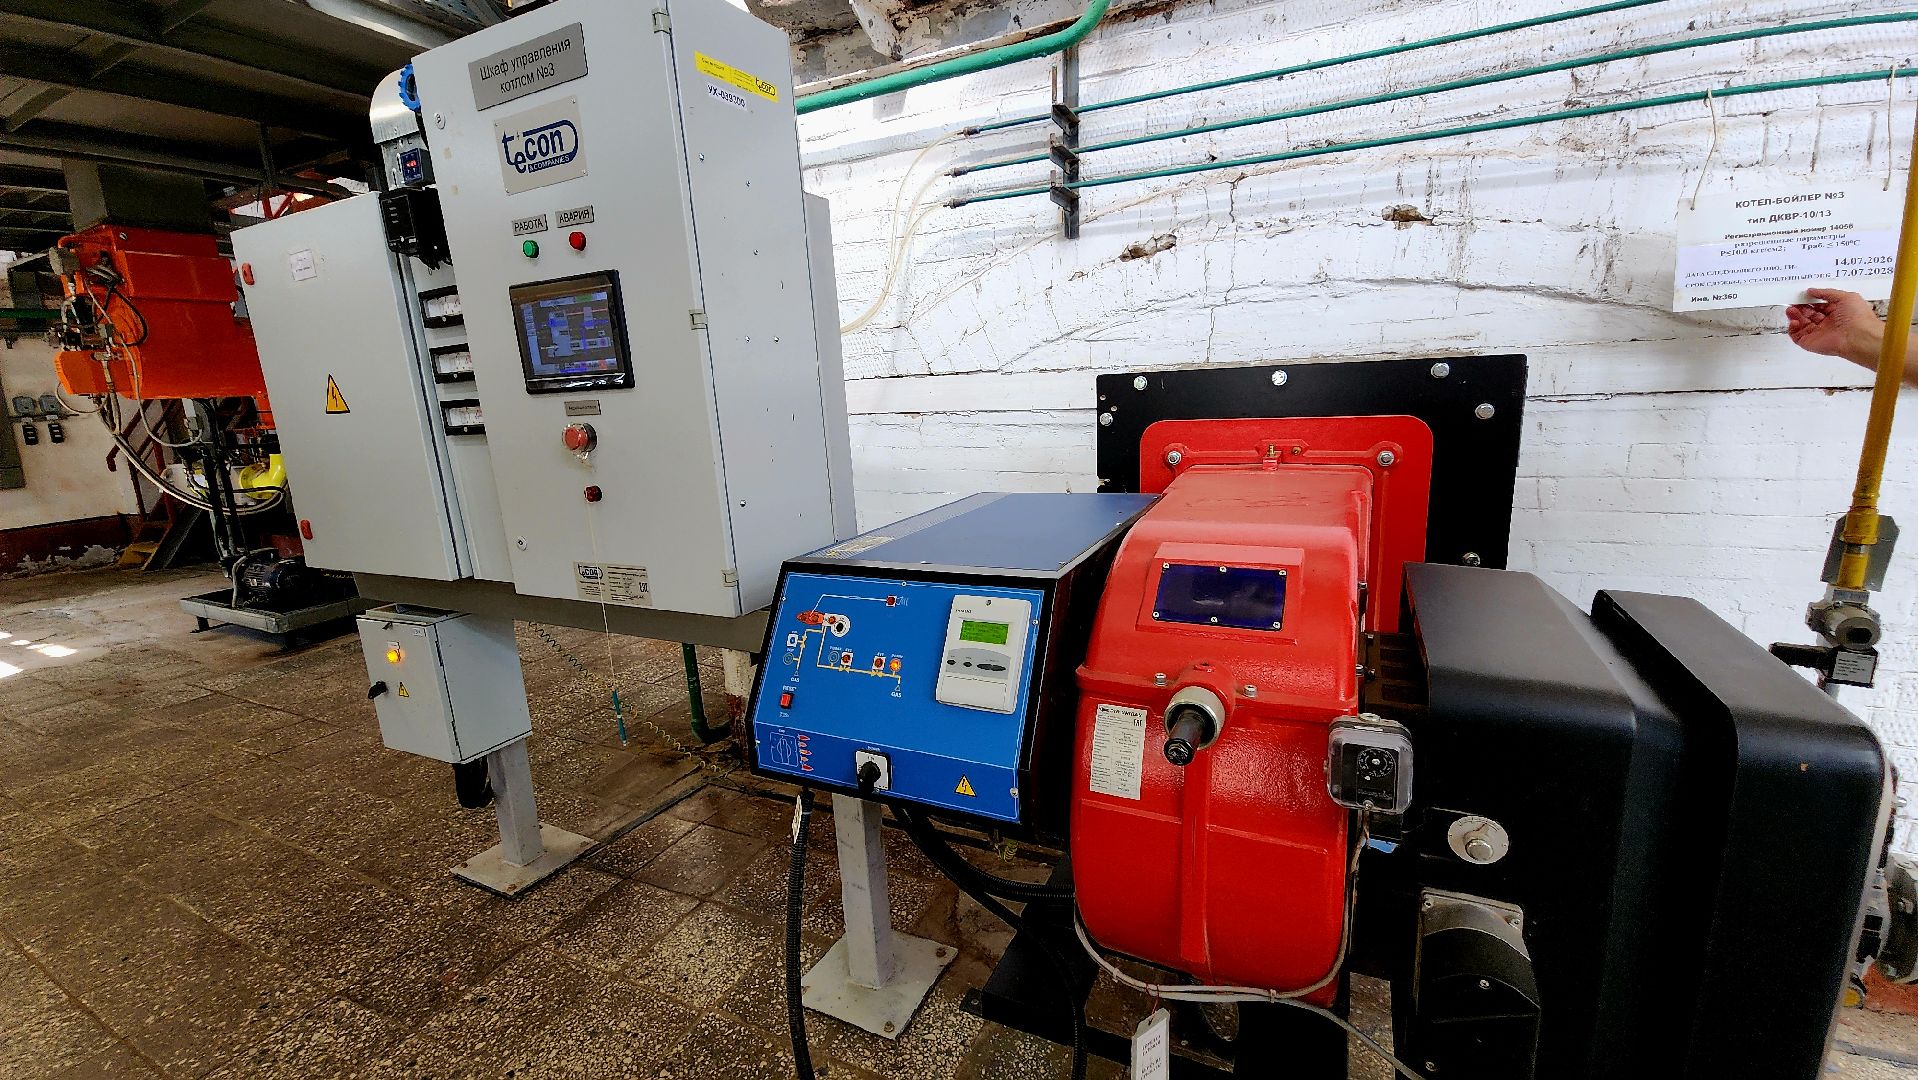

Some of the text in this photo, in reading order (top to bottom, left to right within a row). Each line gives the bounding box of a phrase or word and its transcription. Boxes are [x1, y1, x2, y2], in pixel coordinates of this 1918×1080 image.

[479, 38, 571, 81] Шкаф управления
[500, 62, 555, 94] котлом №3
[1735, 191, 1845, 209] КОТЕЛ-БОЙЛЕР №3
[559, 209, 590, 223] АВАРИЯ
[1768, 209, 1832, 223] ДКВР-10/13
[514, 218, 543, 232] РАБОТА
[1800, 225, 1827, 234] номер
[1796, 233, 1846, 243] параметры
[1834, 255, 1893, 266] 14.07.2026
[1835, 266, 1893, 278] 17.07.2028
